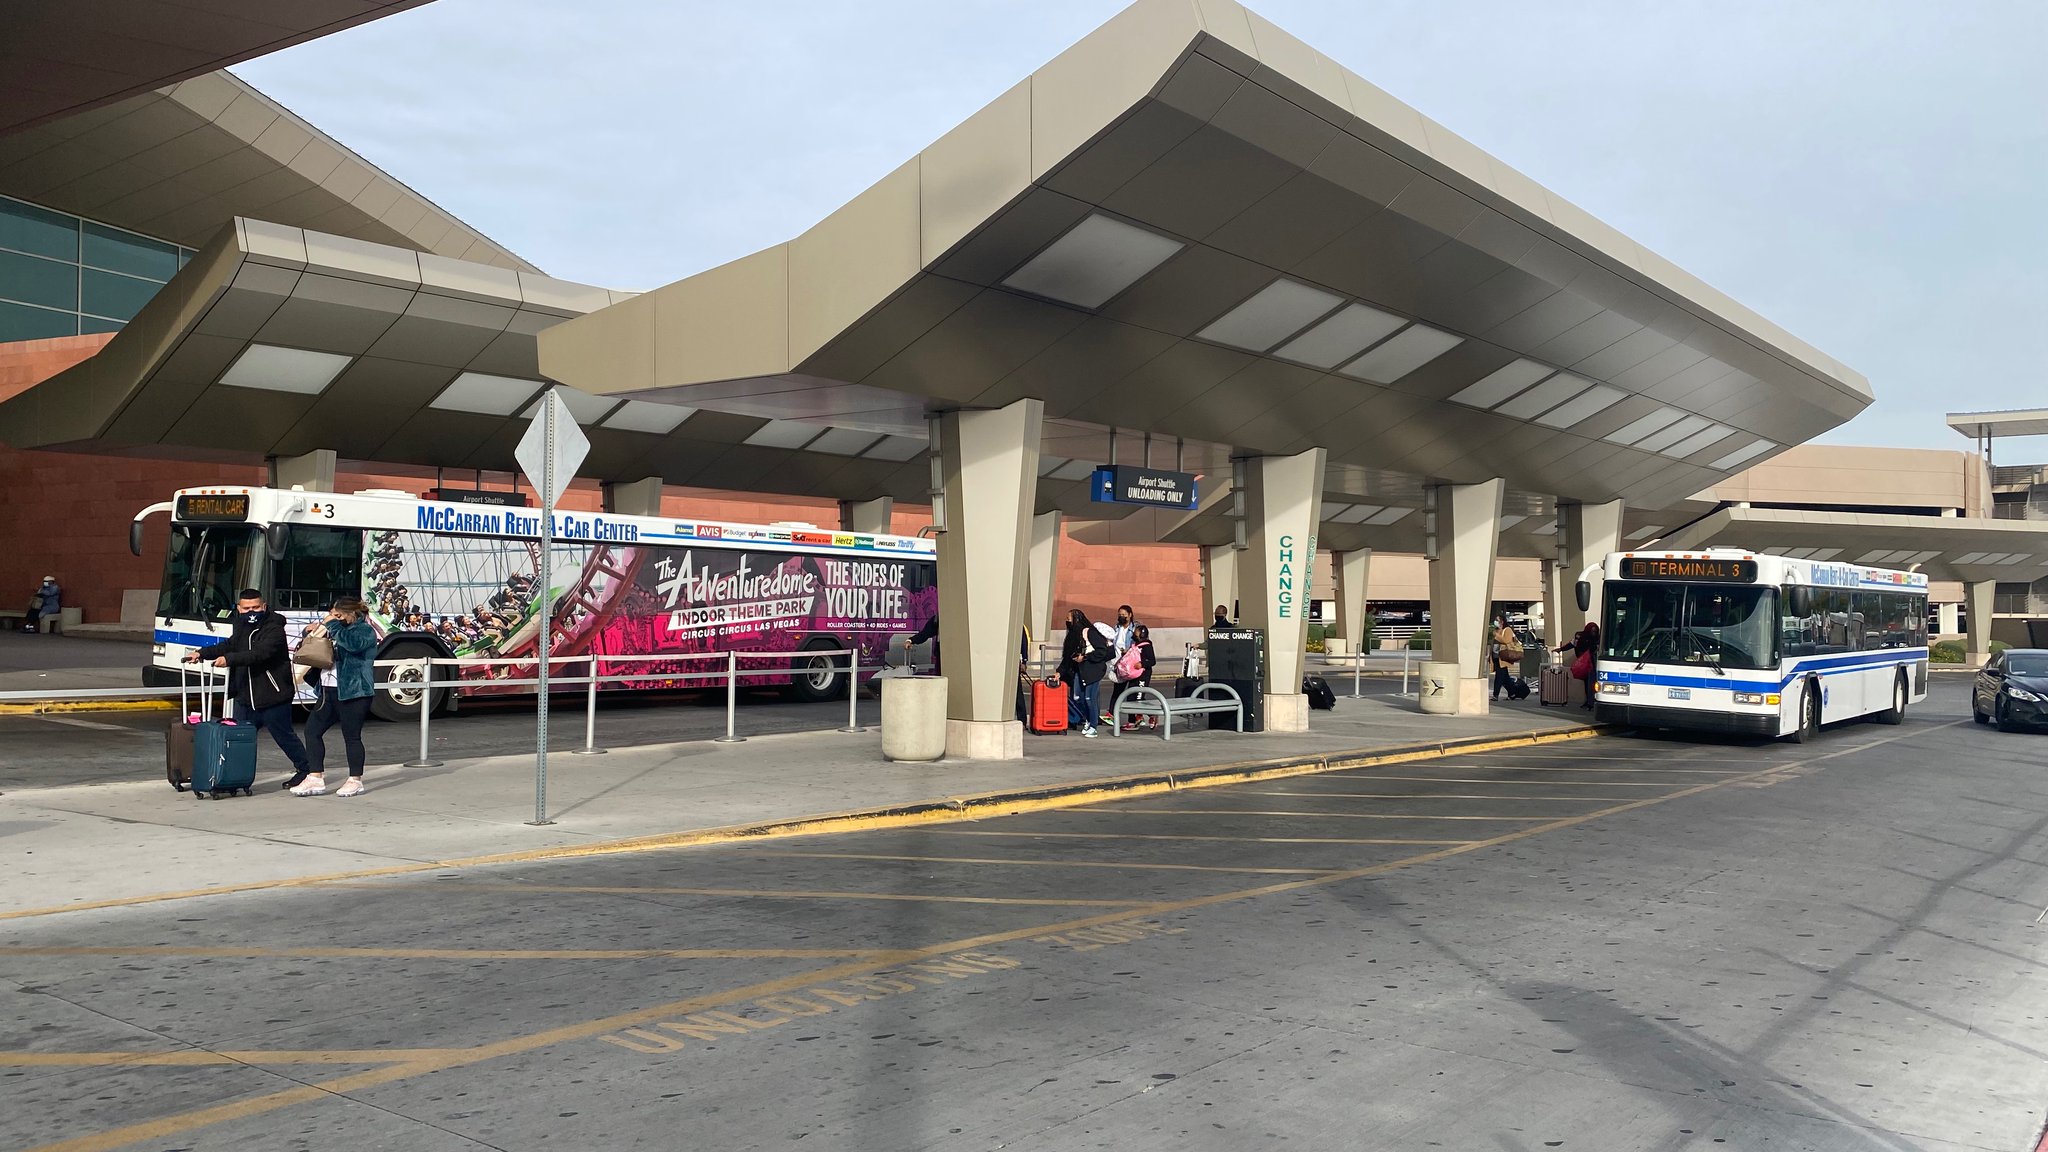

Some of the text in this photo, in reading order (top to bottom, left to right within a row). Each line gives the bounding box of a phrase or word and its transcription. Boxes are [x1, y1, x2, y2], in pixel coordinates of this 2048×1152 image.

[1138, 476, 1176, 489] Airport Shuttle
[462, 495, 505, 504] Airport Shuttle
[1127, 486, 1184, 503] UNLOADING ONLY
[196, 499, 245, 516] RENTAL CARS
[324, 503, 335, 519] 3
[594, 517, 638, 542] CENTER
[699, 526, 720, 537] AVIS
[729, 529, 746, 537] Budget
[835, 536, 853, 545] Hertz
[654, 556, 677, 581] The
[825, 561, 905, 588] THE RIDES OF
[1278, 535, 1293, 618] CHANGE
[1650, 562, 1740, 577] TERMINAL 3
[655, 549, 815, 609] Adventuredome
[825, 589, 908, 619] YOUR LIFE.
[677, 599, 807, 627] INDOOR THEME PARK
[681, 619, 800, 640] CIRCUS CIRCUS LAS VEGAS
[1208, 632, 1254, 640] CHANGE CHANGE
[1599, 672, 1608, 681] 34
